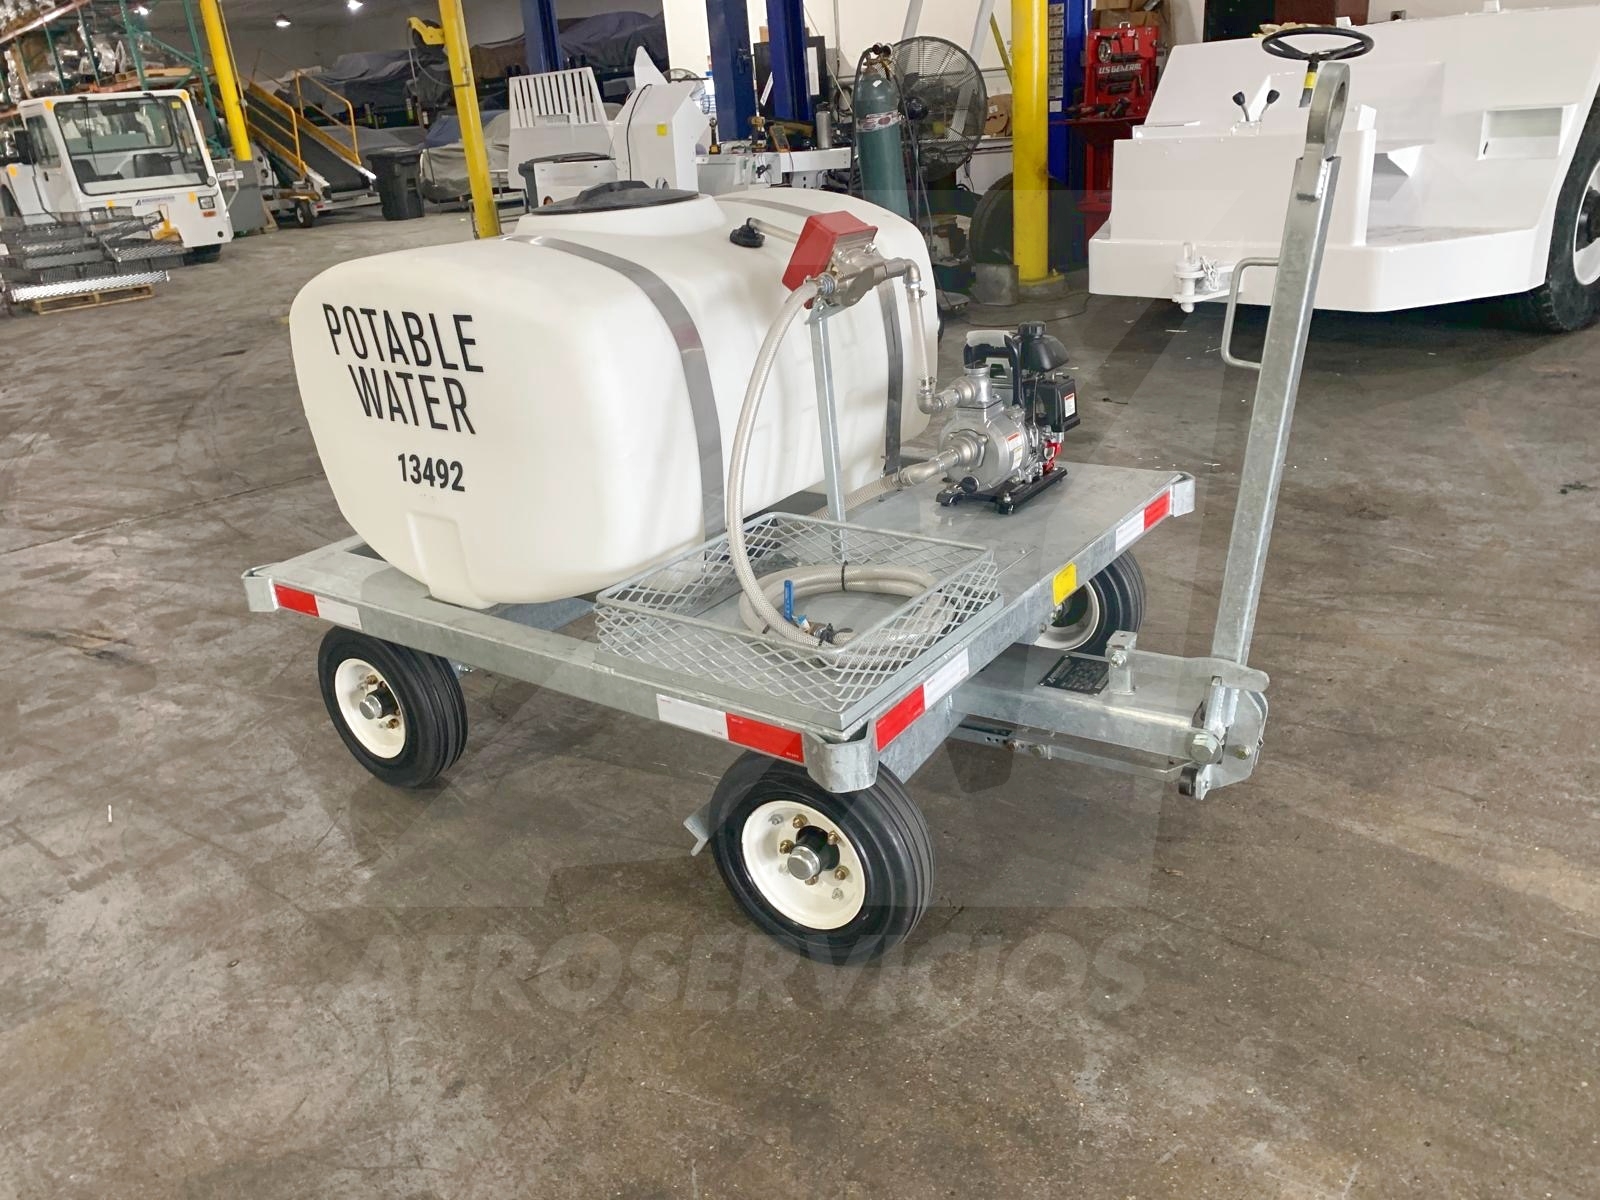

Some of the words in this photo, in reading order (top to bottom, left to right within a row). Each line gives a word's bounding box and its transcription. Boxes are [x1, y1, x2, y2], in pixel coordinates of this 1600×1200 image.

[1111, 63, 1142, 73] GENERAL
[322, 303, 484, 373] POTABLE
[348, 364, 476, 434] WATER
[398, 453, 465, 492] 13492
